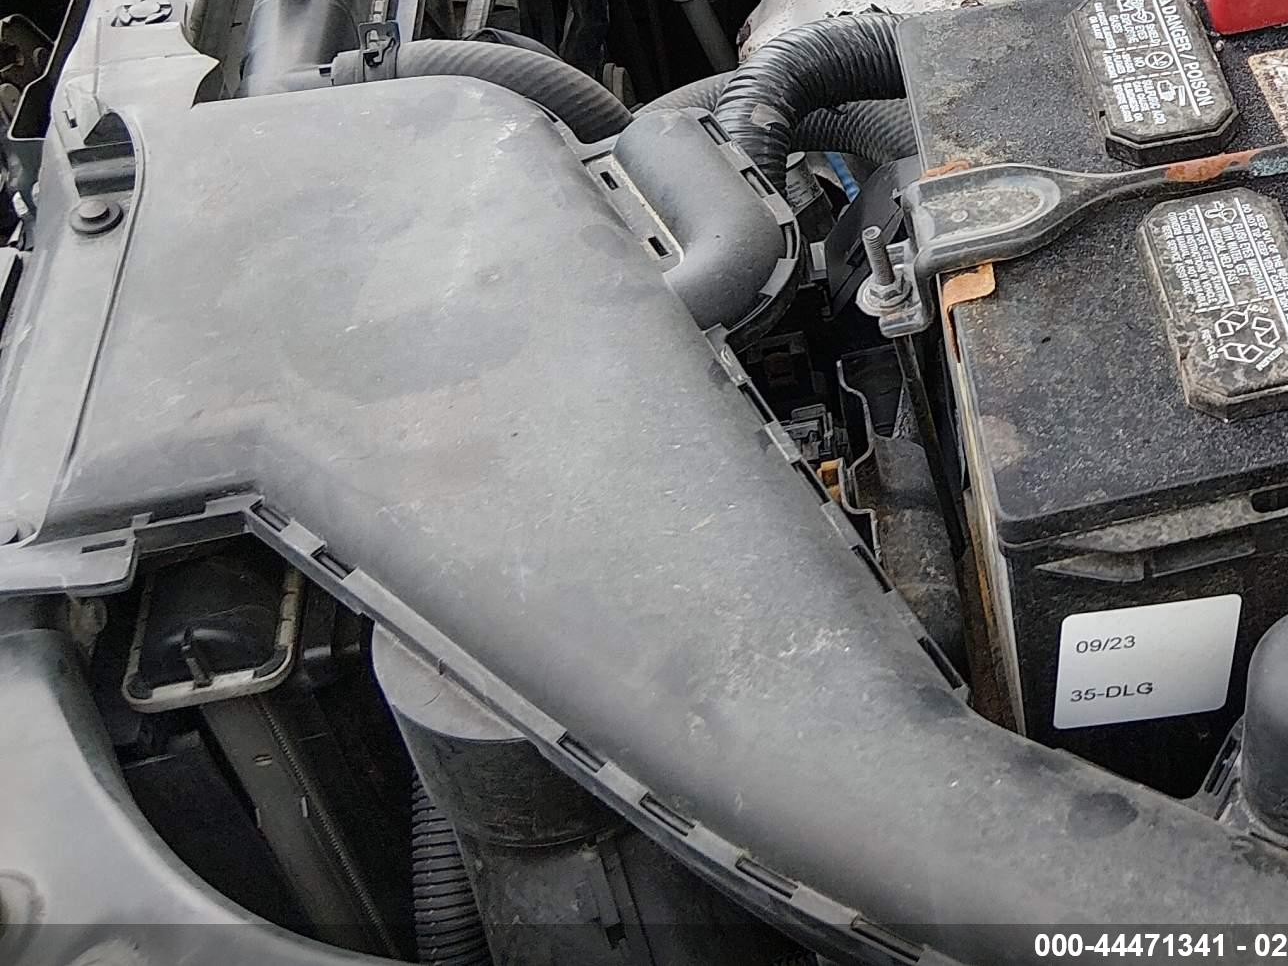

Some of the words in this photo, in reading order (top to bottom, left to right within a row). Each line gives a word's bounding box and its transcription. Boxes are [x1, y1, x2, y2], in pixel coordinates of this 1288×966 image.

[1132, 56, 1146, 67] NO
[1160, 5, 1193, 52] DANGER
[1182, 61, 1215, 107] POISON
[1241, 203, 1252, 213] DO
[1244, 213, 1257, 226] NOT
[1254, 214, 1268, 229] KEEP
[1231, 223, 1249, 242] FLUSH
[1261, 230, 1274, 243] OUT
[1266, 243, 1279, 253] OF
[1218, 253, 1234, 269] HELP
[1225, 269, 1240, 285] FAST
[1235, 263, 1249, 276] GET
[1269, 274, 1284, 291] CAPS
[1076, 635, 1136, 654] 09/23
[1070, 682, 1154, 702] 35-DLG
